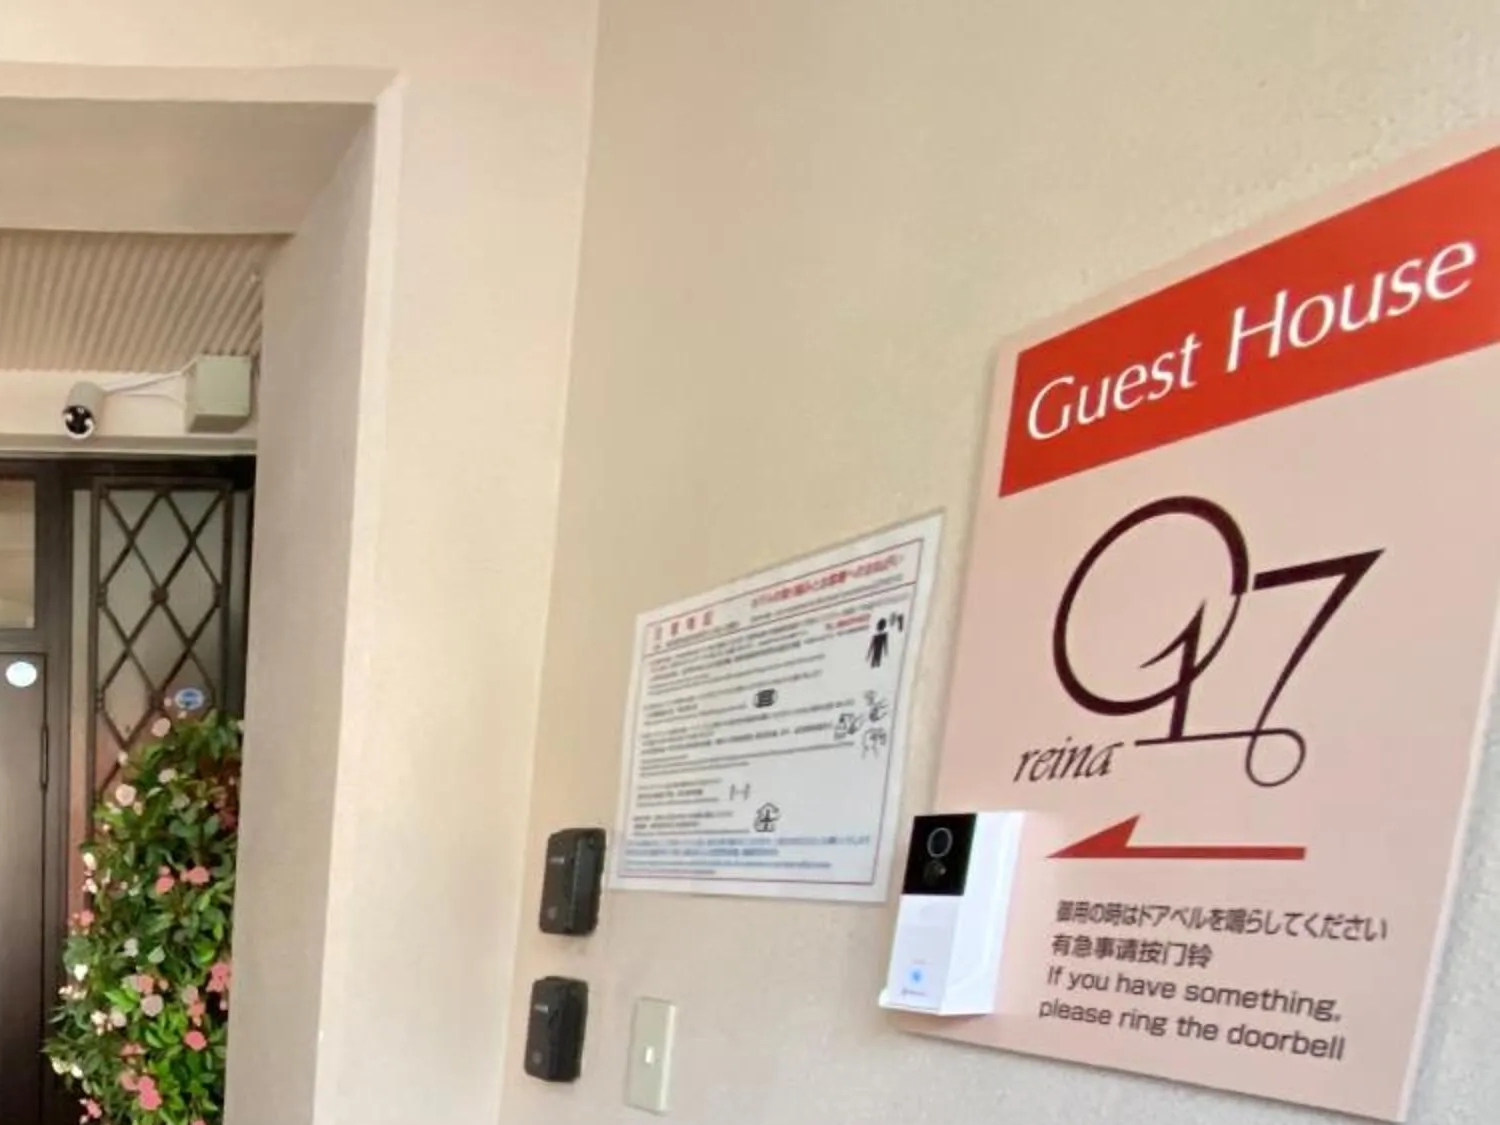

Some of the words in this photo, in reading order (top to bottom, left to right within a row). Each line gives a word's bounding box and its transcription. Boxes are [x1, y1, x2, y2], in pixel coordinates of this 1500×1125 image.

[1025, 331, 1202, 442] Guest
[1225, 239, 1477, 374] House
[1013, 736, 1125, 784] reina
[1051, 934, 1214, 969] 有急事请按门铃
[1047, 965, 1064, 985] If
[1066, 971, 1110, 991] you
[1115, 972, 1177, 999] have
[1038, 998, 1112, 1025] please
[1118, 1008, 1168, 1037] ring
[1176, 1015, 1219, 1041] the
[1226, 1023, 1346, 1061] doorbell
